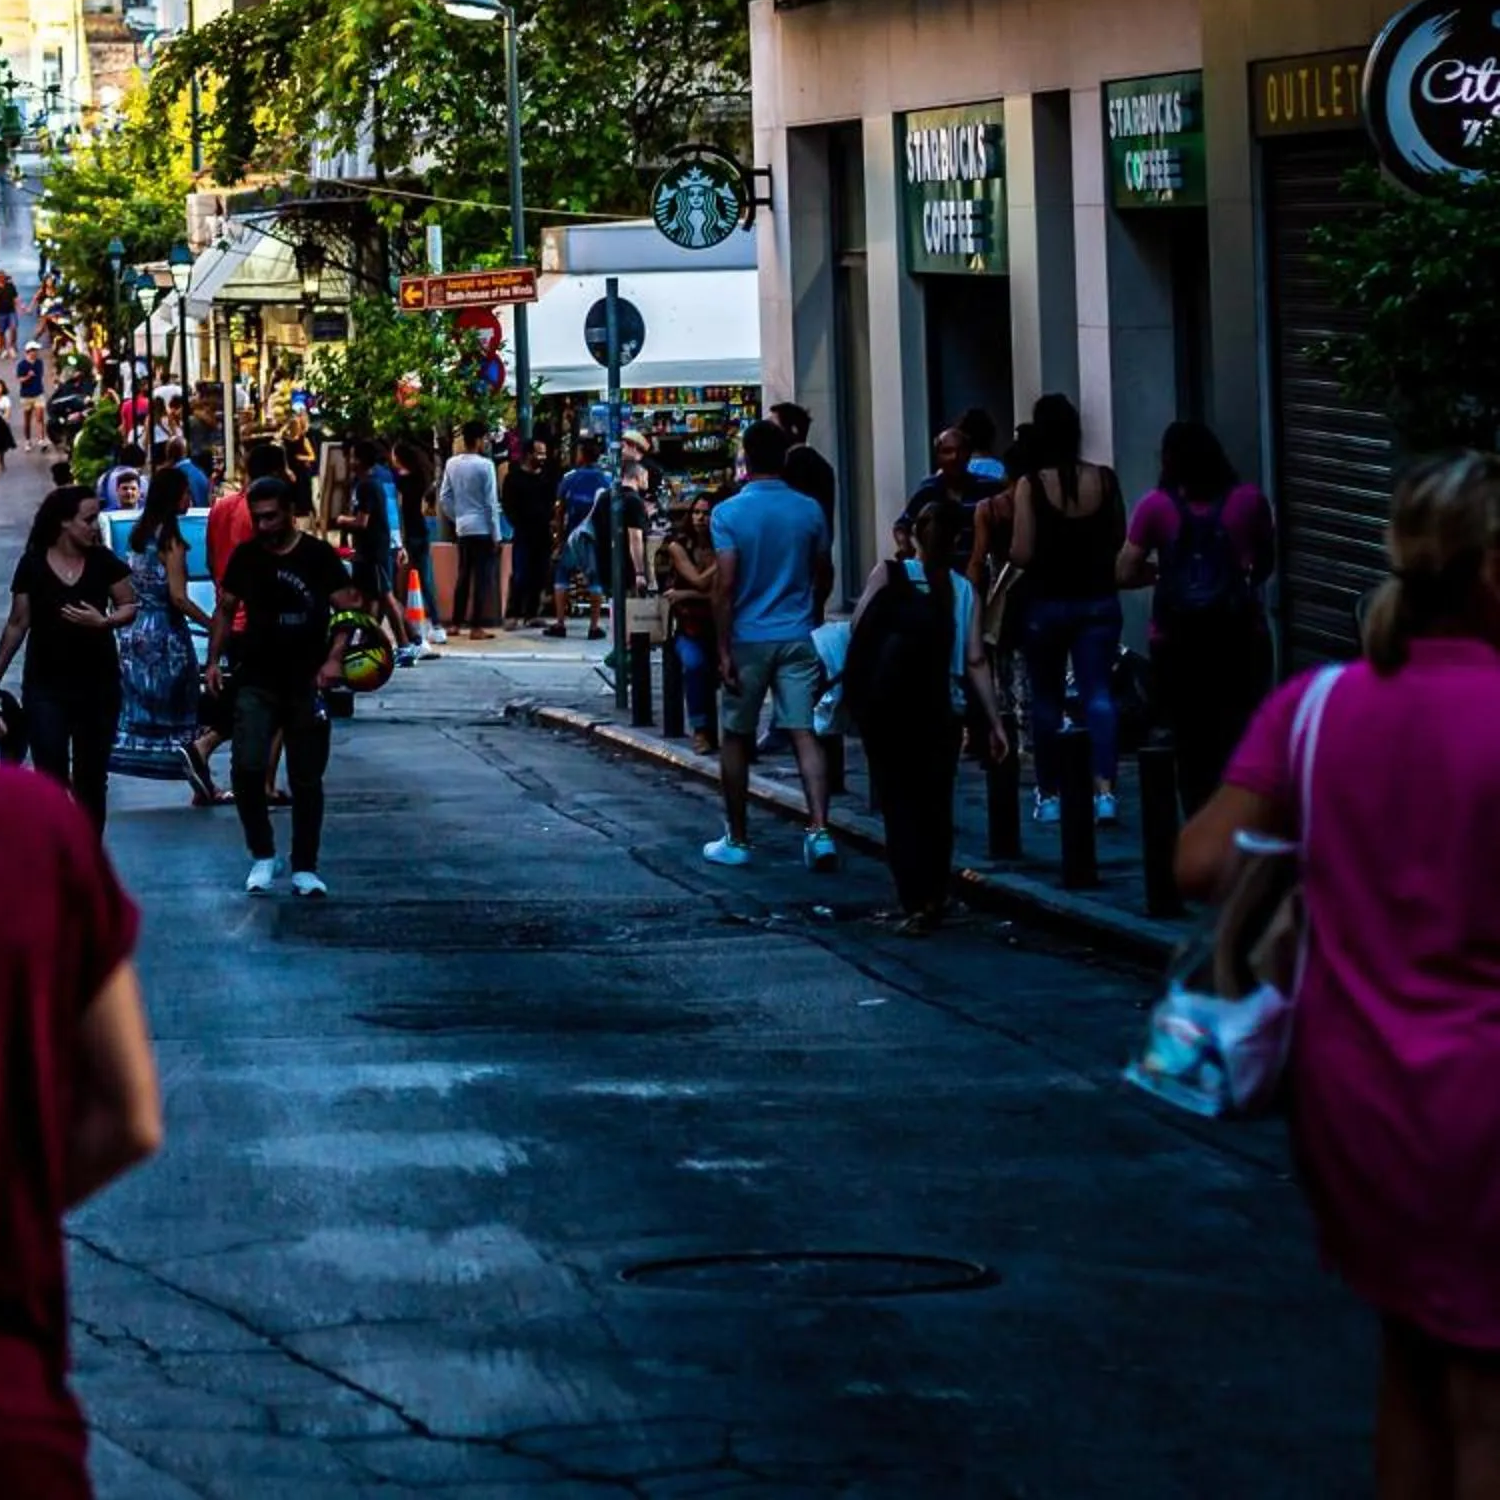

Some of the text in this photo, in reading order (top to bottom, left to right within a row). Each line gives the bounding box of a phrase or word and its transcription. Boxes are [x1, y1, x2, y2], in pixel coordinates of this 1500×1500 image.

[1108, 90, 1181, 140] STARBUCKS
[1266, 63, 1359, 123] OUTLET
[906, 122, 987, 184] STARBUCKS
[923, 199, 976, 254] COFFEE
